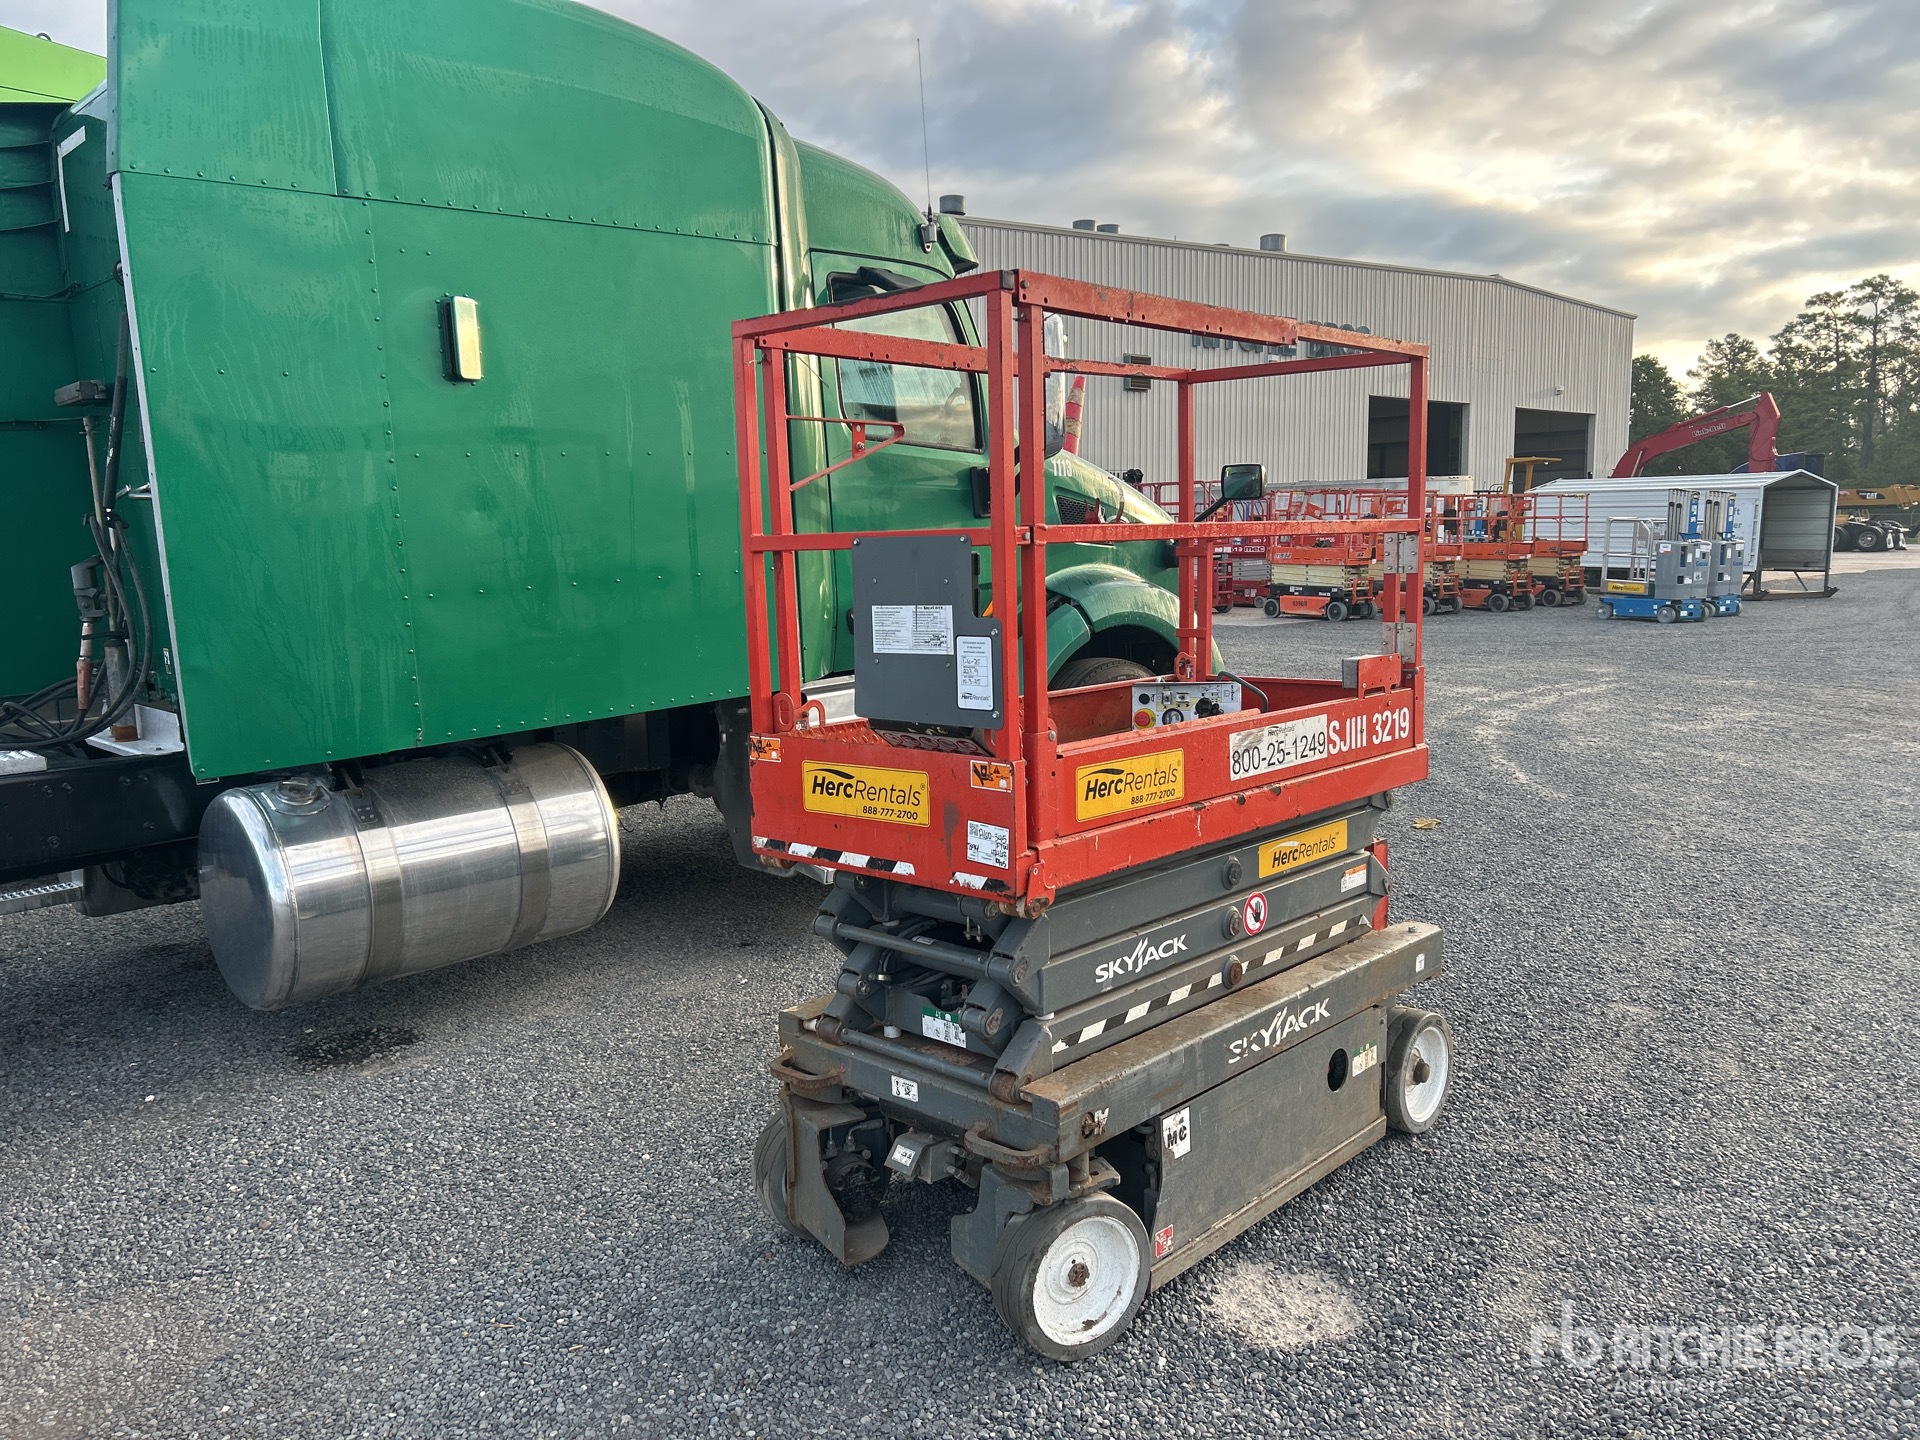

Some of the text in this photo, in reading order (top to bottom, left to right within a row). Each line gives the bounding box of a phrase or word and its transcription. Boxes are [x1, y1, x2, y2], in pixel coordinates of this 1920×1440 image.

[1051, 460, 1073, 477] 1113
[1372, 707, 1410, 745] 3219
[1232, 731, 1326, 775] 800-25-1249
[811, 775, 921, 807] HercRentals
[1085, 764, 1178, 801] HercRentals
[1130, 788, 1175, 805] 888-777-2700
[862, 805, 918, 820] 888-777-2700
[1272, 834, 1336, 868] HercRentals
[1095, 934, 1188, 983] SKYJACK
[1228, 998, 1331, 1064] SKYJACK
